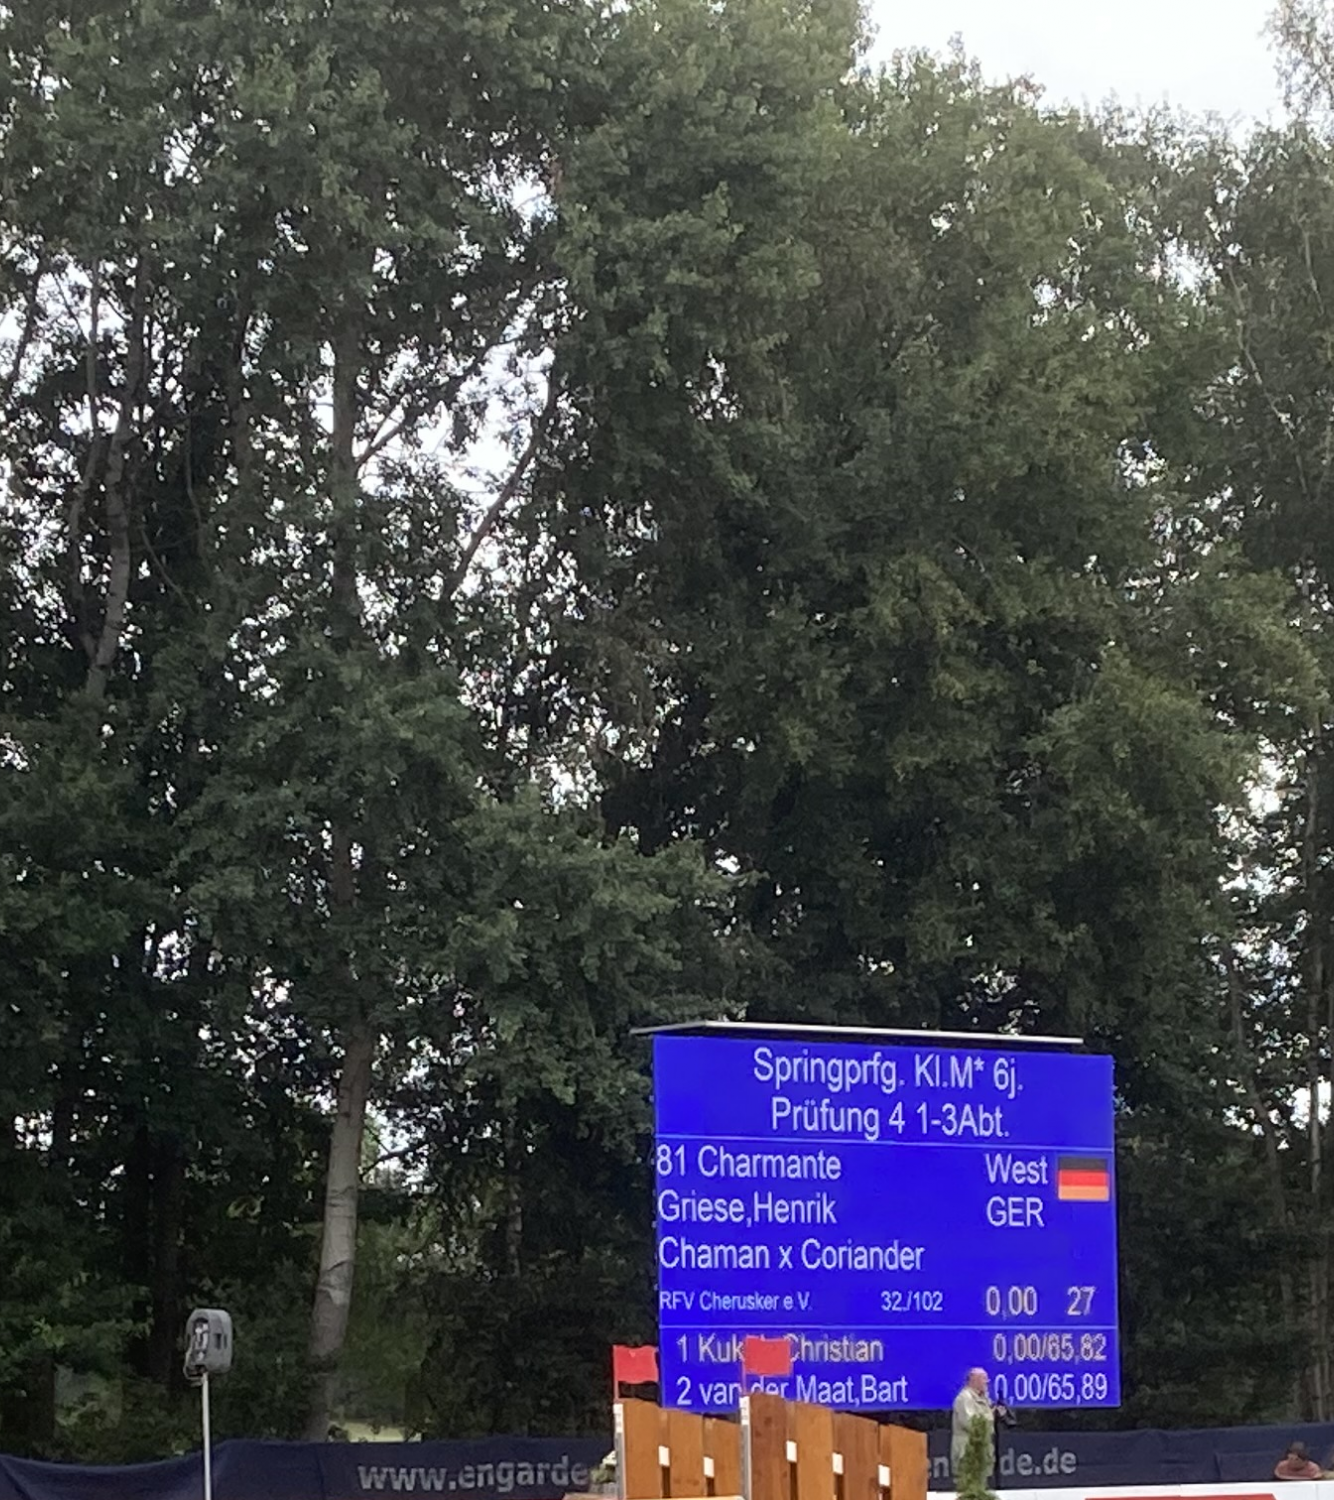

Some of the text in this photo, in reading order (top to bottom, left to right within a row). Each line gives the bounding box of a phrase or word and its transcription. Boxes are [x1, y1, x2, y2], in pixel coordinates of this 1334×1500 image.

[753, 1046, 906, 1094] Springprfg.
[993, 1057, 1024, 1099] 6j.
[771, 1096, 1011, 1141] Prüfung 4 1-3Abt.
[656, 1143, 842, 1181] 81 Charmante
[984, 1152, 1049, 1186] West
[657, 1188, 838, 1228] Griese,Henrik
[986, 1195, 1046, 1228] GER
[658, 1235, 925, 1272] Chaman x Coriander
[658, 1290, 696, 1311] RFV
[698, 1289, 780, 1312] Cherusker
[984, 1284, 1097, 1320] 0,00 27
[676, 1333, 688, 1363] 1
[676, 1375, 693, 1406] 2
[698, 1381, 743, 1406] van
[795, 1373, 909, 1407] Maat,Bart
[993, 1372, 1109, 1406] 0,00/65,89
[356, 1455, 590, 1493] www.engarde
